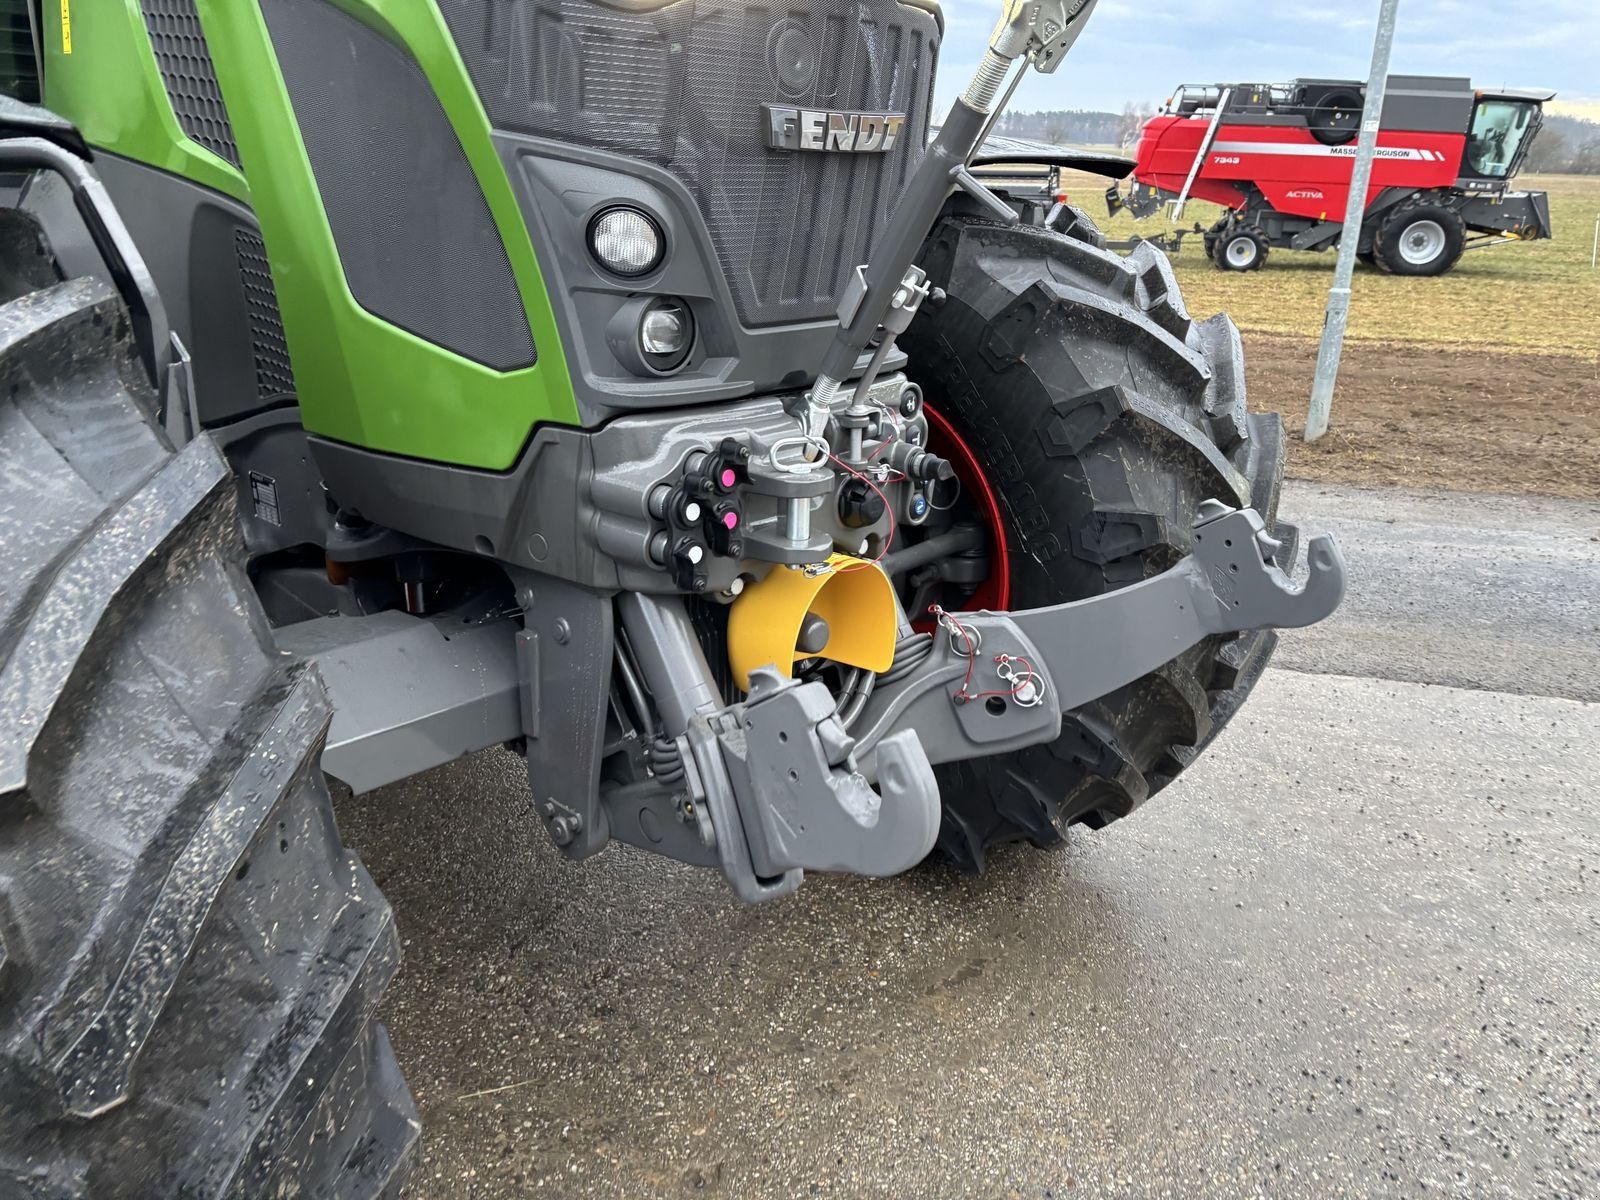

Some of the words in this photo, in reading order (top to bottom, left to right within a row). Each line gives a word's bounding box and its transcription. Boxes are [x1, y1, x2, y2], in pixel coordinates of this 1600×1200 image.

[769, 105, 905, 150] FENDT
[1330, 147, 1357, 155] MASSE
[1214, 156, 1240, 164] 7343
[1285, 190, 1324, 199] ACTIVA
